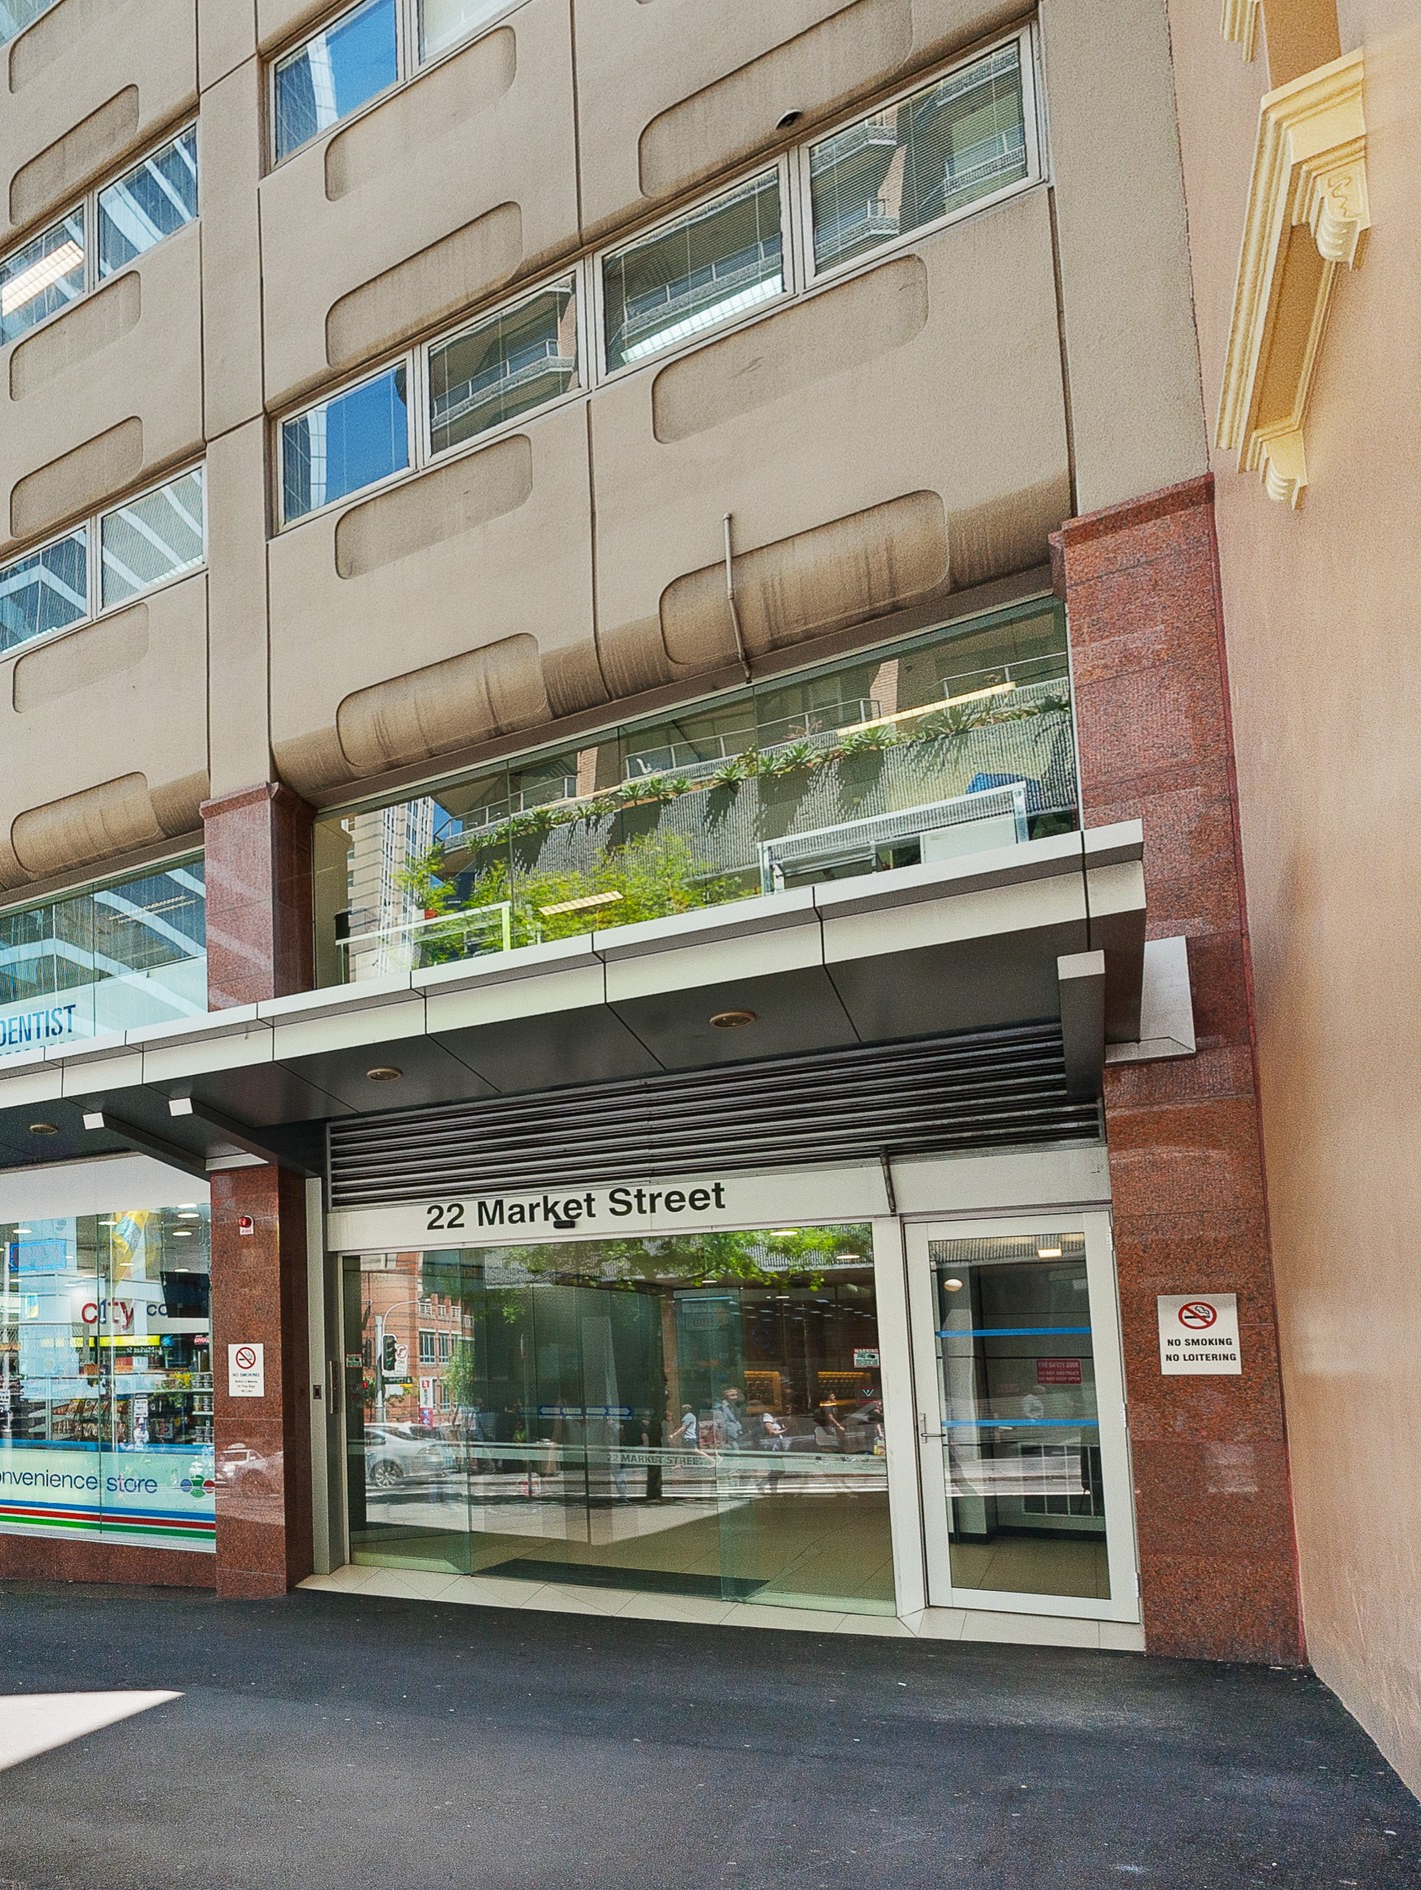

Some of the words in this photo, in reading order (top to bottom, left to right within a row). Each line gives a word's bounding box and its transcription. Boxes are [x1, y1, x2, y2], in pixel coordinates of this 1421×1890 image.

[426, 1202, 465, 1231] 22
[477, 1192, 596, 1227] Market
[608, 1182, 726, 1217] Street
[1167, 1338, 1181, 1347] NO
[1184, 1338, 1233, 1347] SMOKING
[1165, 1353, 1180, 1362] NO
[1183, 1353, 1237, 1362] LOITERING
[606, 1454, 618, 1462] 22
[621, 1454, 664, 1464] MARKET
[666, 1456, 705, 1466] STREET
[106, 1476, 158, 1494] store
